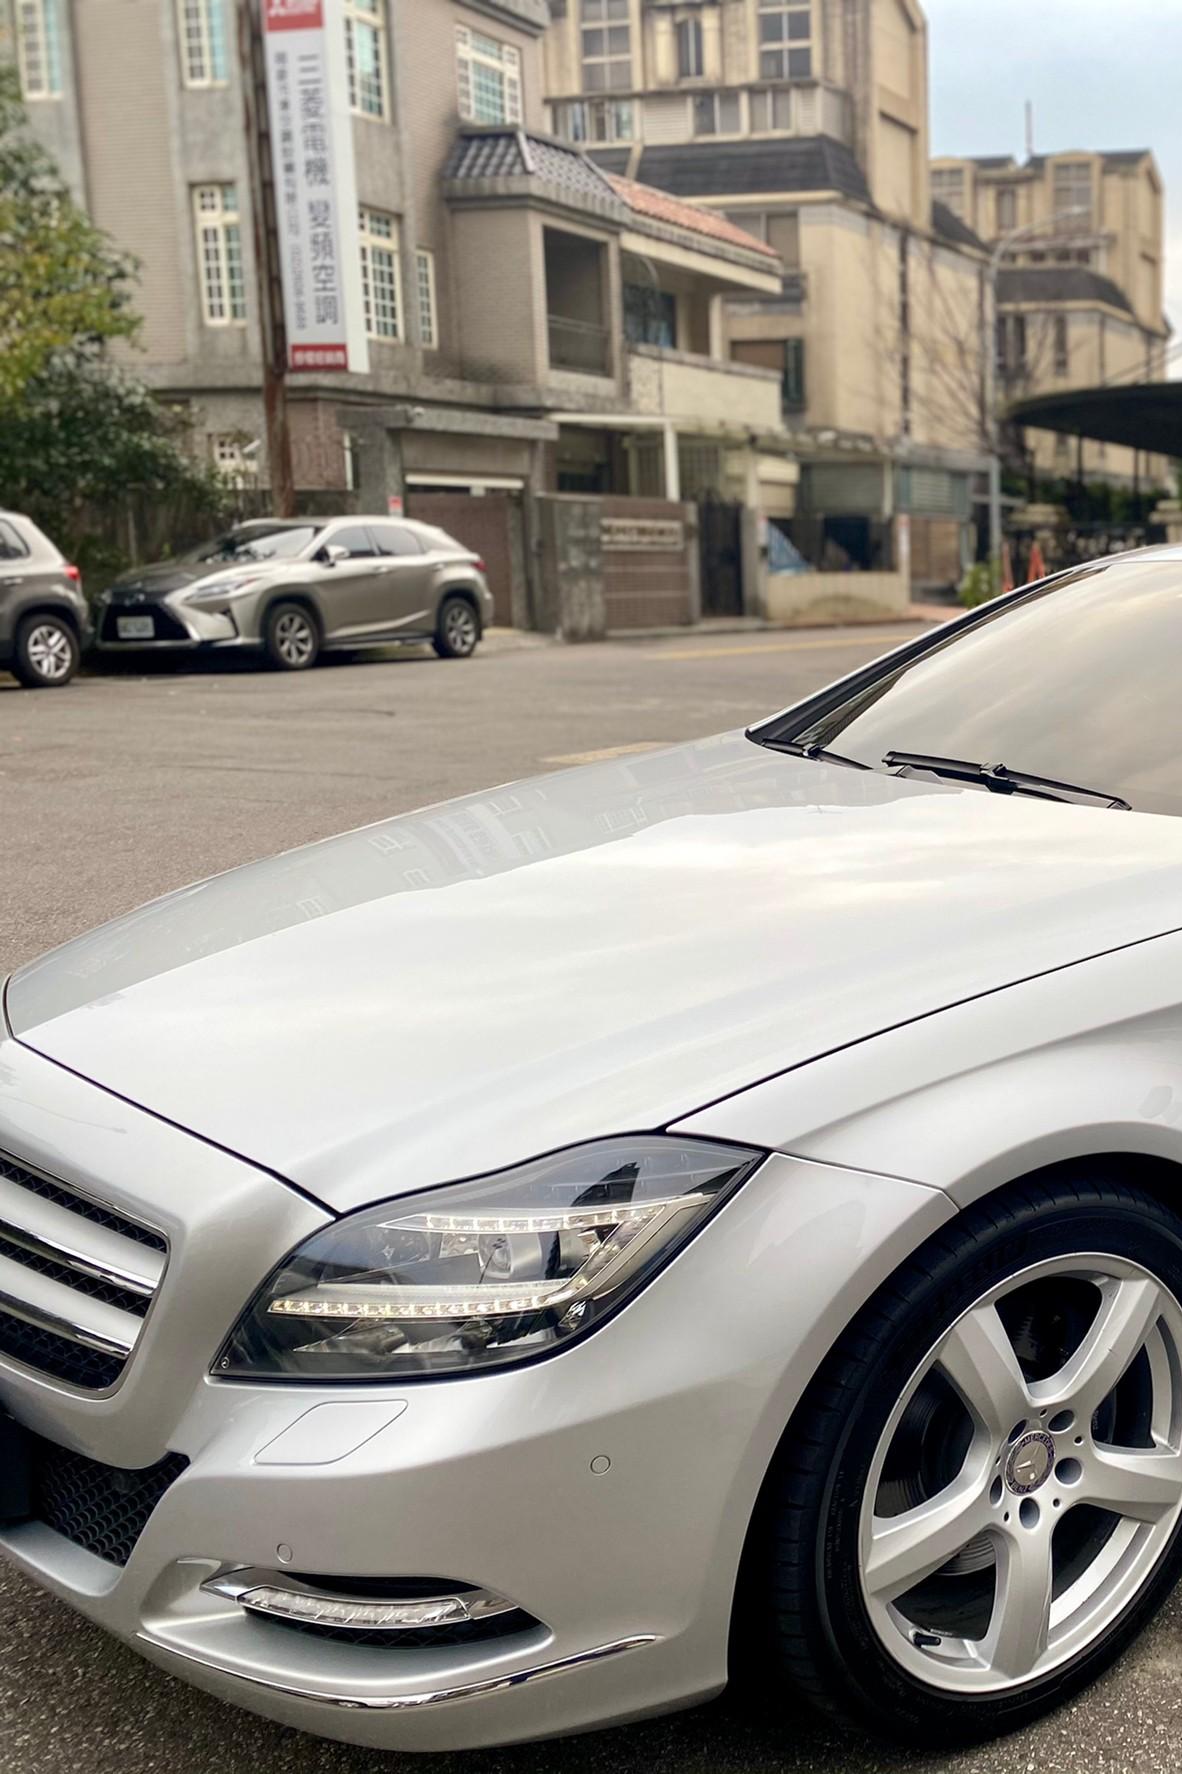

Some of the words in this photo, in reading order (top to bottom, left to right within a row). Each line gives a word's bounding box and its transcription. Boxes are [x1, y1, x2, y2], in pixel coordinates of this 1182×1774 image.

[297, 54, 329, 186] 三菱電機
[308, 199, 339, 326] 變頻空調
